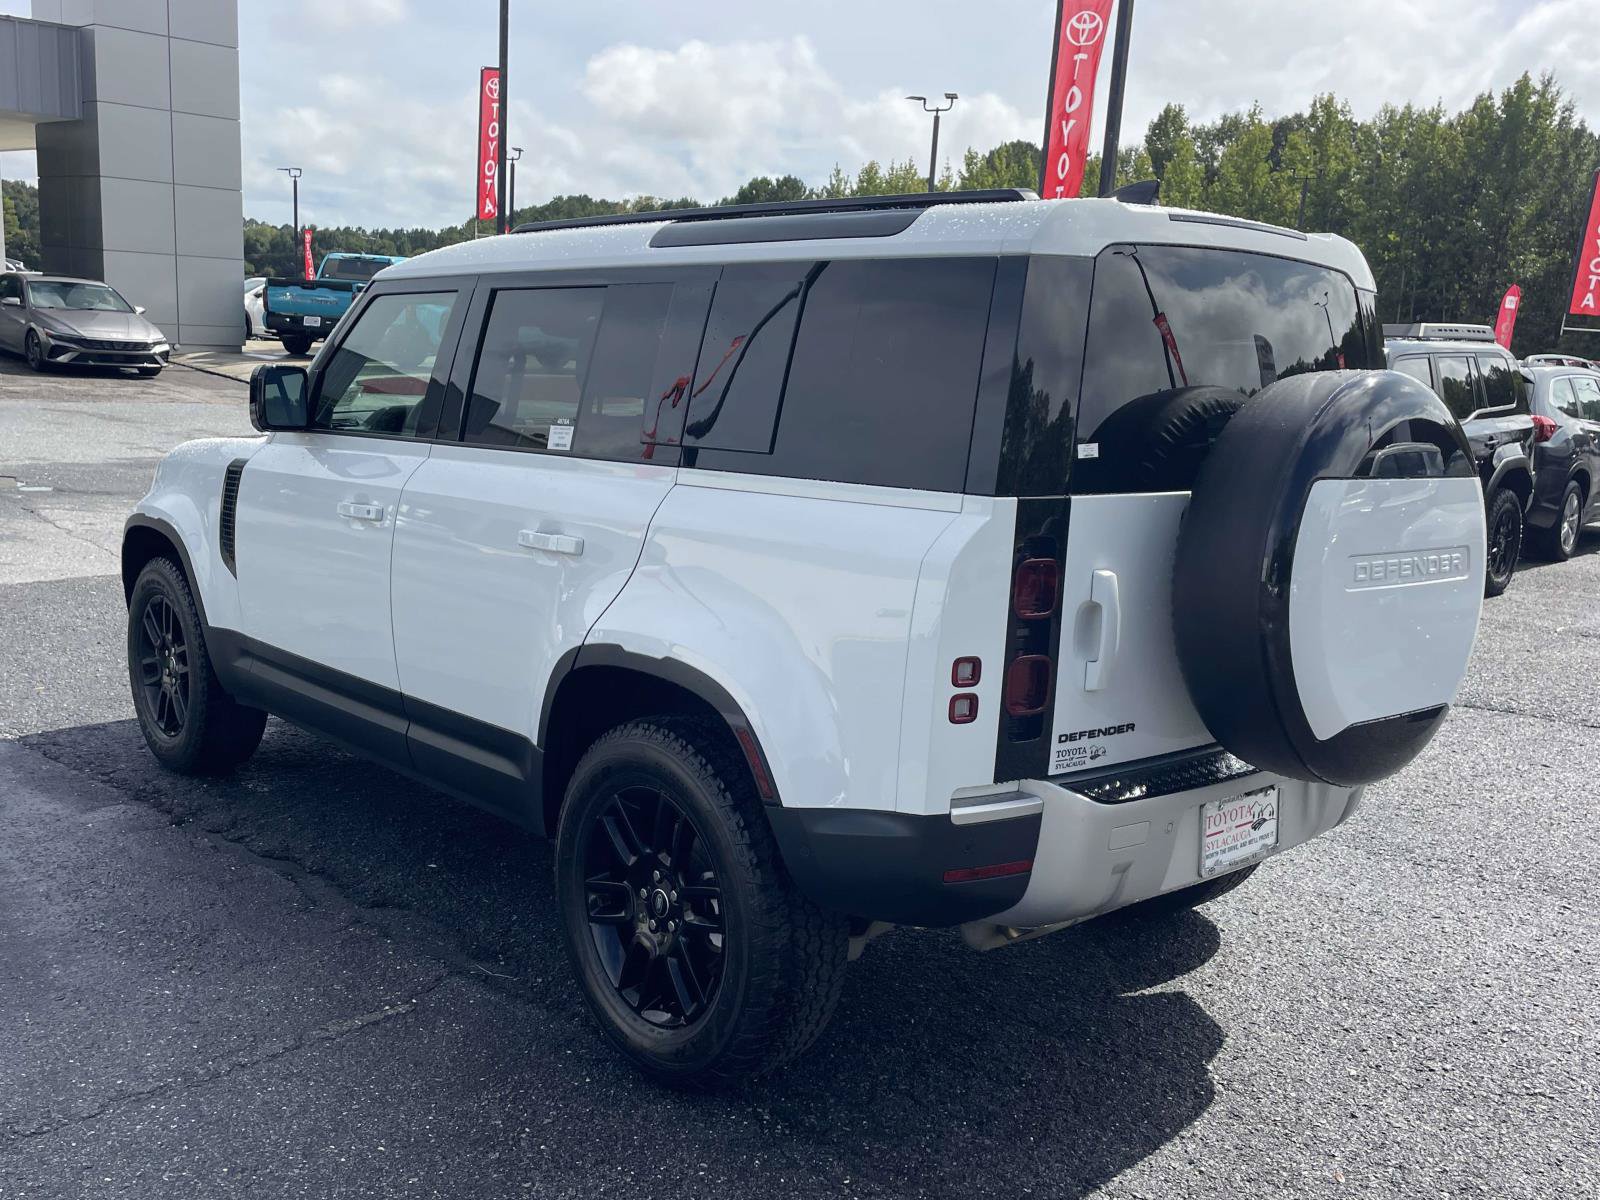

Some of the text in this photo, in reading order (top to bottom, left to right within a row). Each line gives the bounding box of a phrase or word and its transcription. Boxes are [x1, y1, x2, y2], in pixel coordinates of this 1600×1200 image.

[1056, 53, 1089, 199] TOYOT
[484, 102, 499, 214] TOYOTA
[1354, 553, 1462, 582] DEFENDER
[1058, 722, 1136, 744] DEFENDER
[1056, 746, 1087, 759] TOYOTA
[1055, 760, 1086, 770] SYLACAUGA
[1206, 804, 1252, 829] TOYOTA
[1206, 829, 1252, 851] SYLACAUGA
